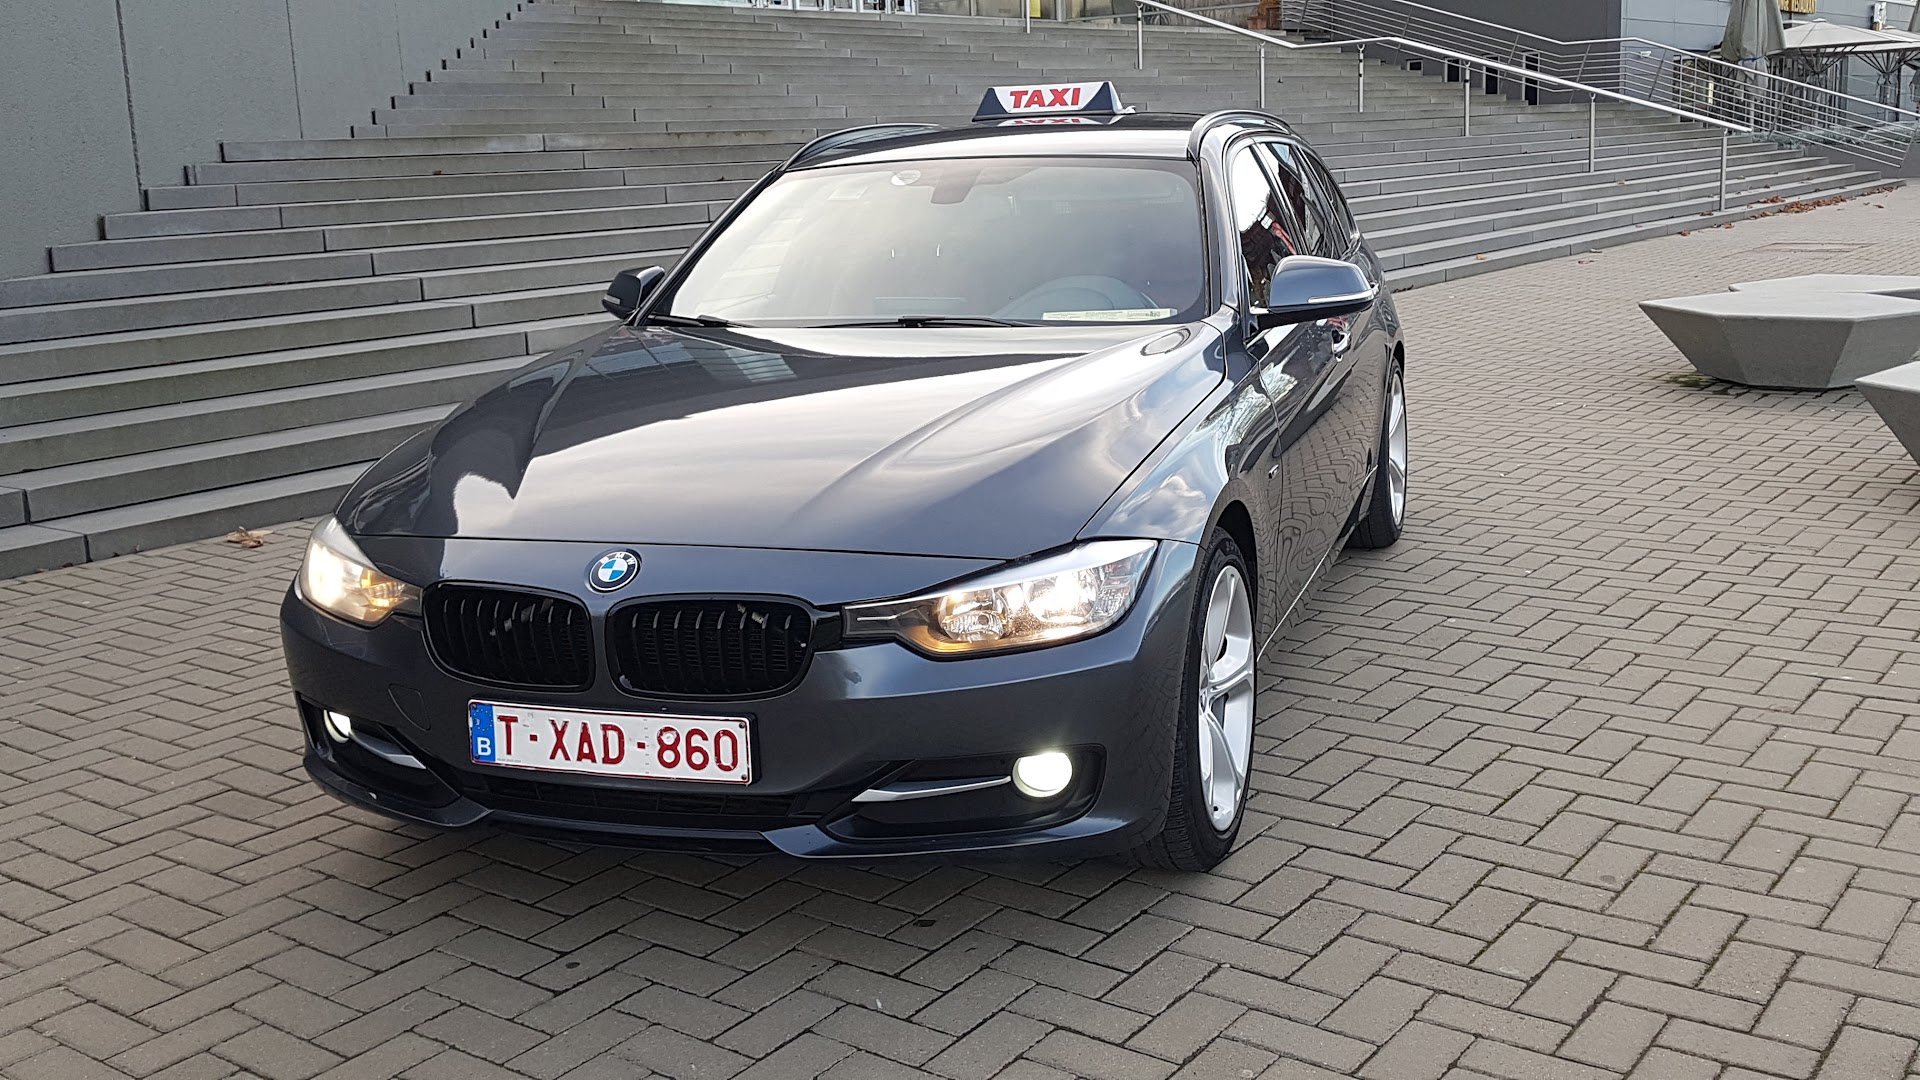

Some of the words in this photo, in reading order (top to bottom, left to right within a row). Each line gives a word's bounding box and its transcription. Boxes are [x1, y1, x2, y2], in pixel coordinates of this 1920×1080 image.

[1010, 87, 1081, 109] TAXI
[600, 552, 635, 565] BMW
[477, 737, 492, 756] B
